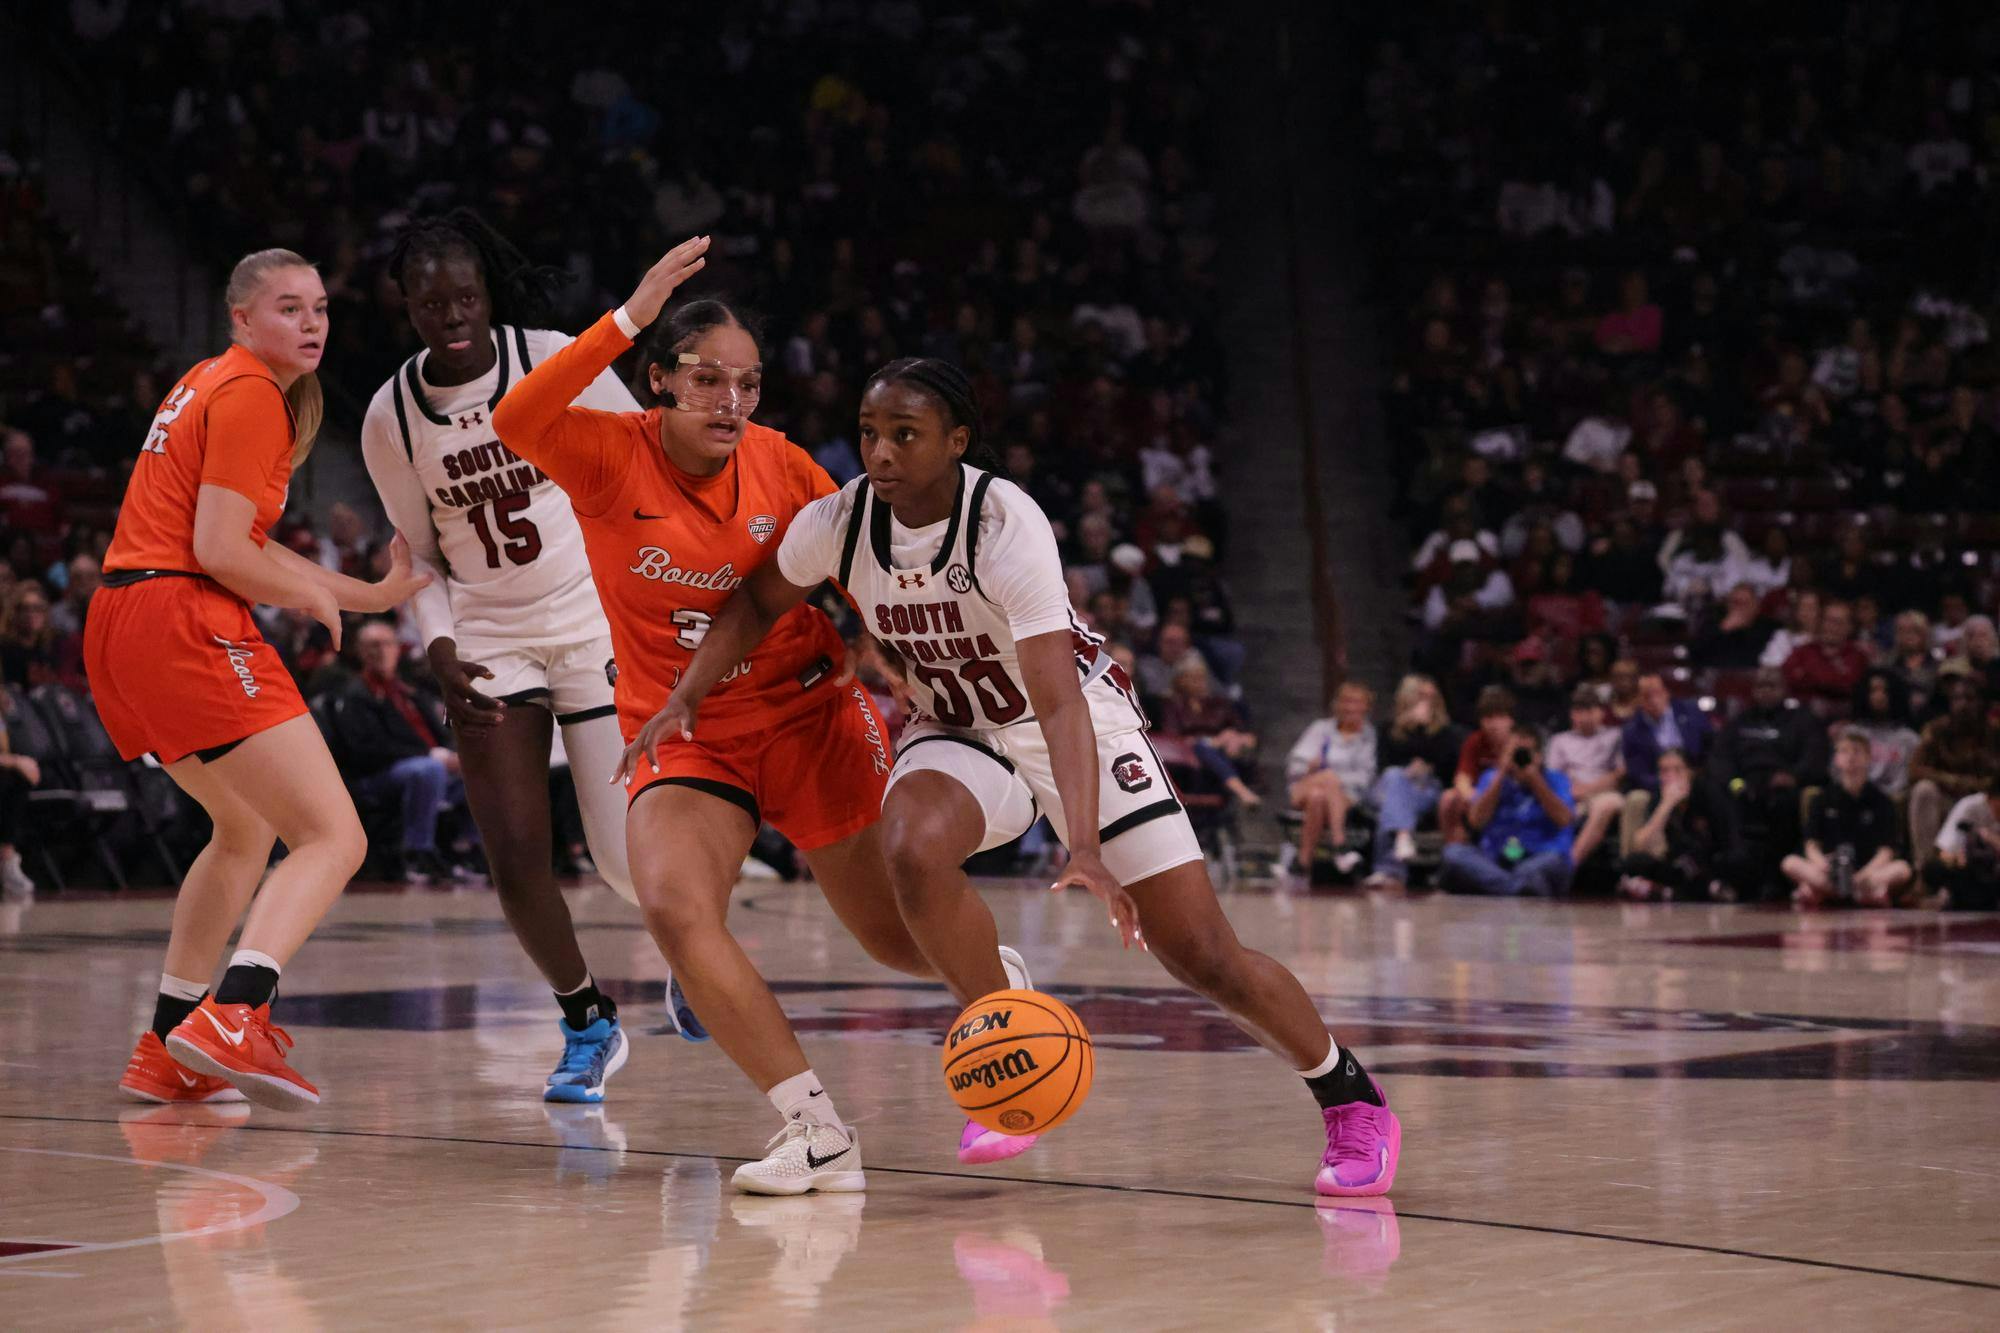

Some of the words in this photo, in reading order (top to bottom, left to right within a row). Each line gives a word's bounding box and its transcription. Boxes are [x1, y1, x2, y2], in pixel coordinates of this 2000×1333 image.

[467, 490, 542, 568] 15
[629, 546, 743, 591] Bowlin
[948, 565, 971, 592] SEC
[875, 601, 964, 635] SOUTH
[894, 633, 1000, 663] ROLINA
[914, 660, 1027, 728] 00
[851, 686, 891, 776] Falcons
[950, 1010, 1012, 1050] NCAA
[950, 1048, 1039, 1092] Wilson
